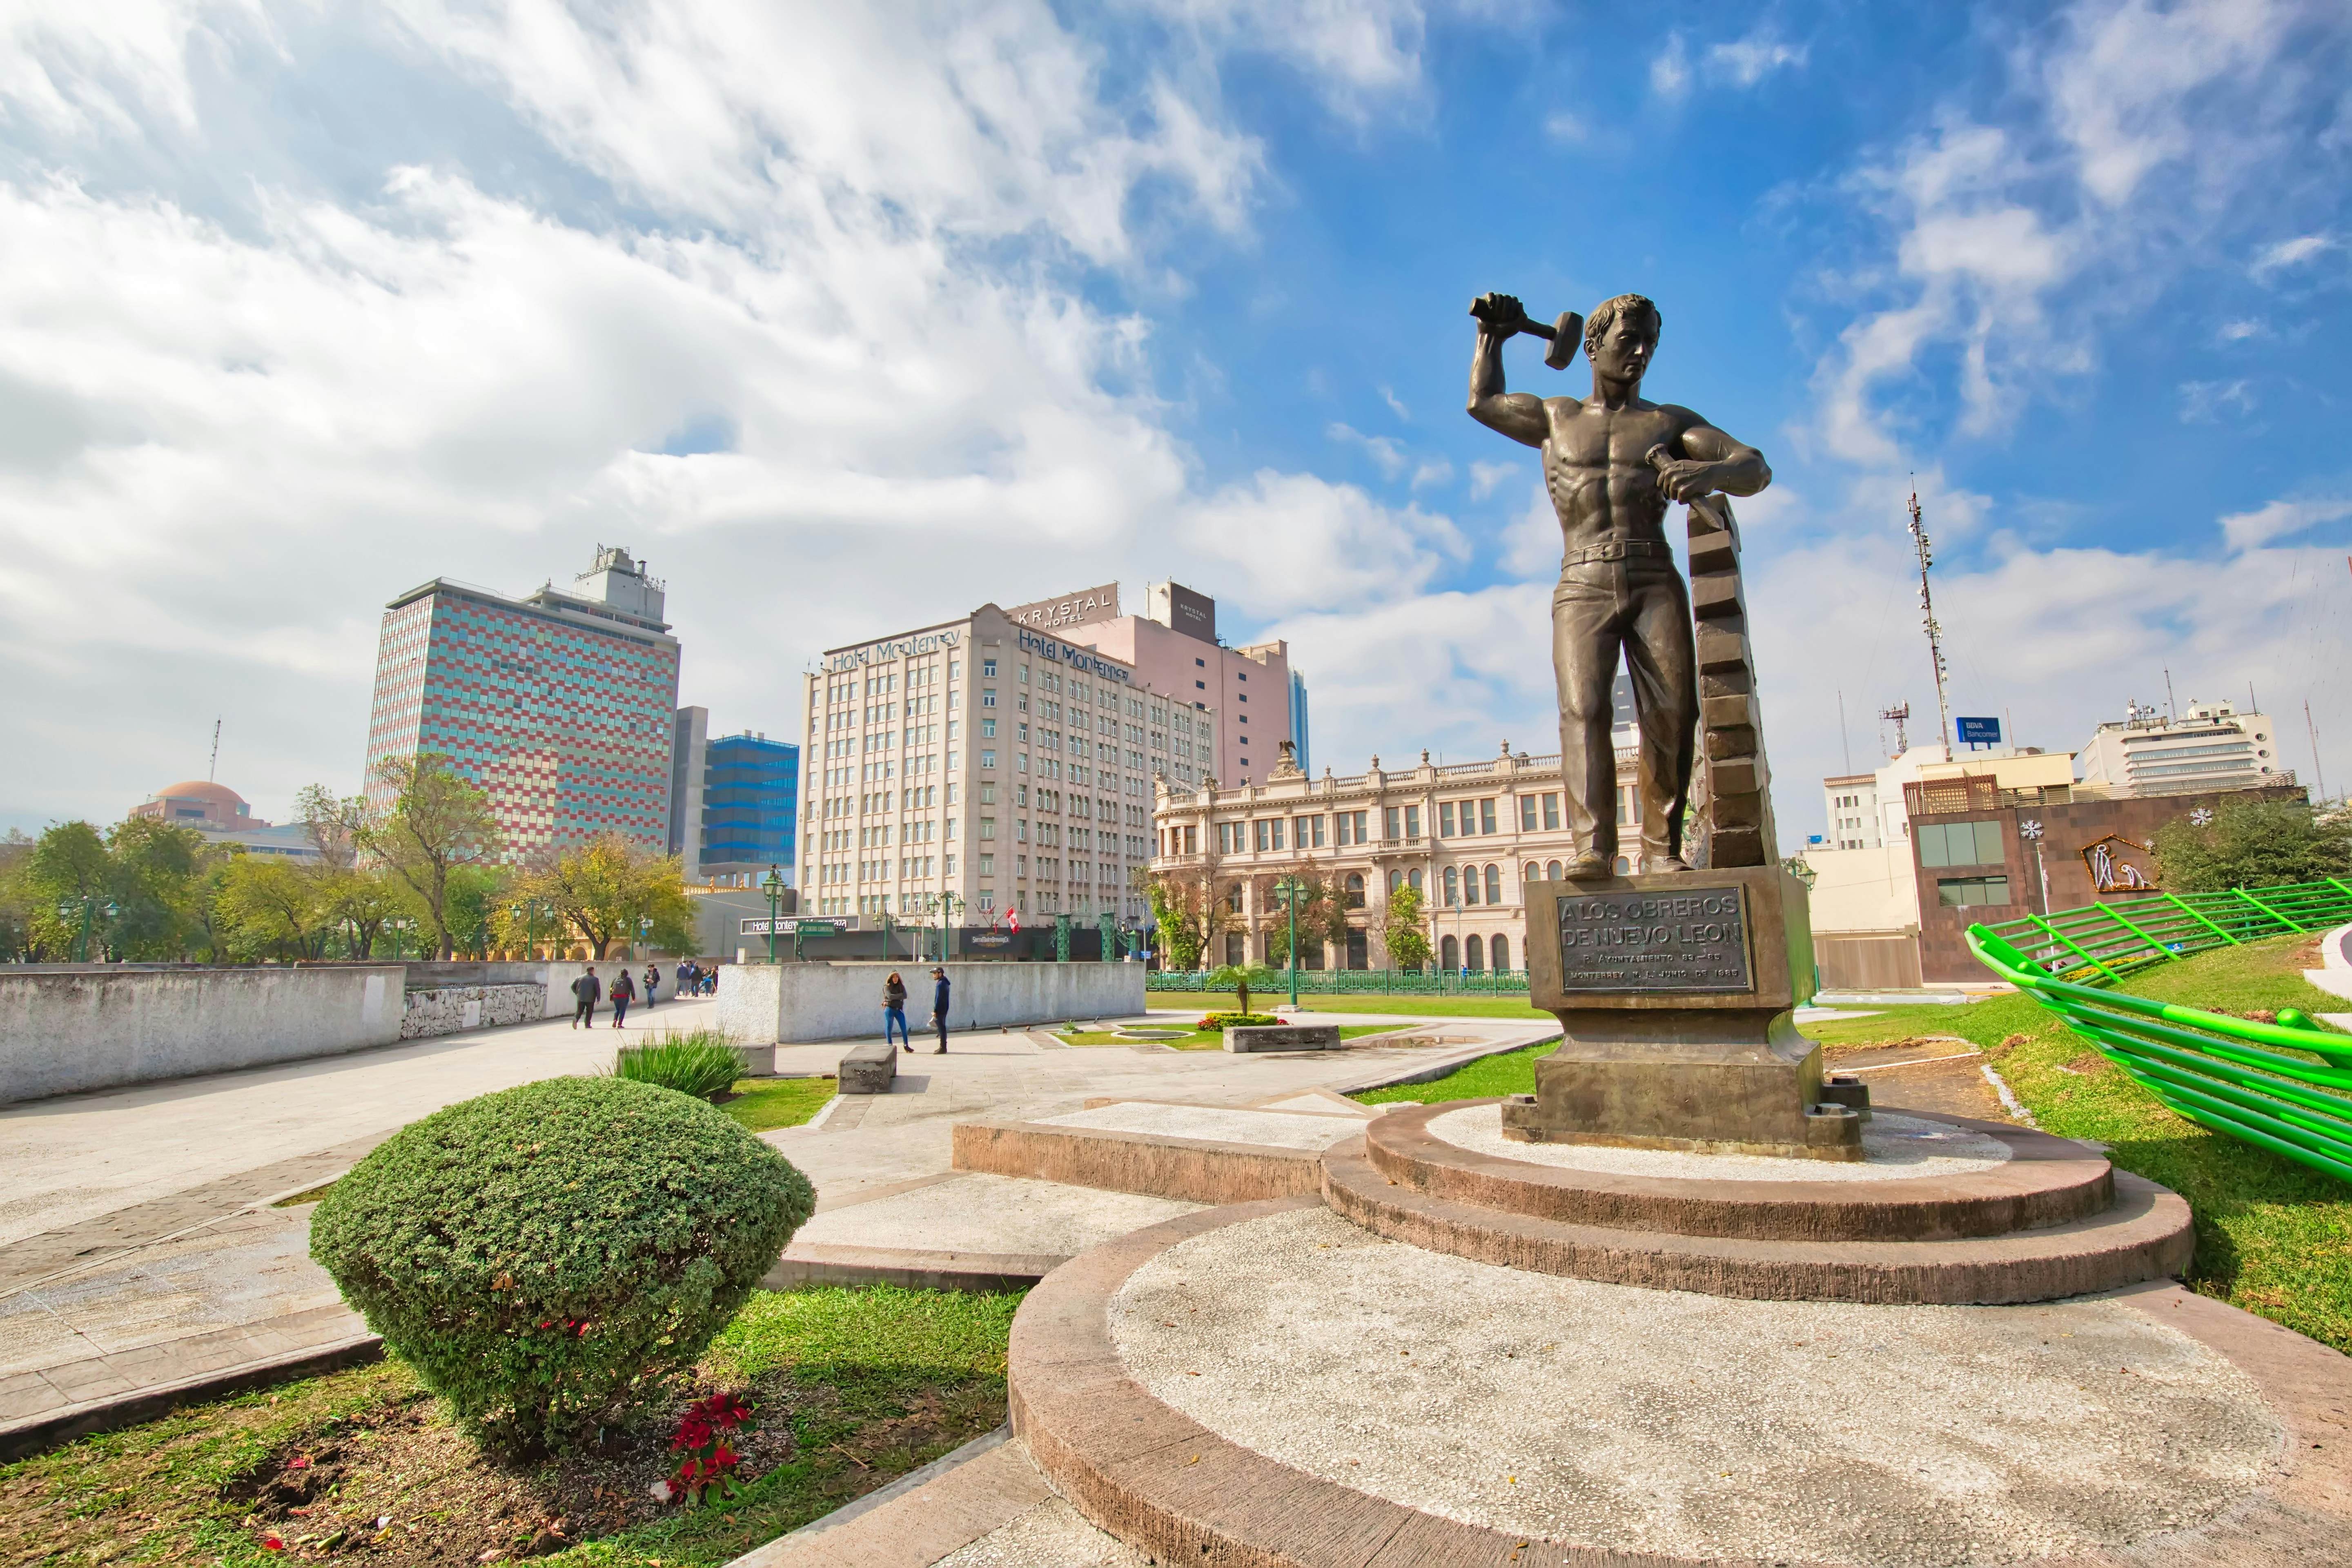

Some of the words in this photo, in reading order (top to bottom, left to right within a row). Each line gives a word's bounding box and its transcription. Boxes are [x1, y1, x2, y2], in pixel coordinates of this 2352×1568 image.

[1018, 594, 1111, 625] KRYSTAL
[1180, 603, 1207, 619] KRYSTAL
[1185, 612, 1201, 621] HOTEL
[1045, 613, 1085, 628] HOTEL
[1019, 629, 1056, 659] Hotel
[1561, 904, 1577, 922] A
[1578, 902, 1621, 921] LOS
[1626, 895, 1738, 919] OBREROS
[753, 921, 769, 931] Hotel
[1562, 928, 1591, 947] DE
[1594, 925, 1671, 946] NUEVO
[1676, 922, 1742, 944] LEON
[1598, 954, 1674, 964] AYUNTAMIENTO
[1659, 970, 1688, 979] JUNIO
[1715, 969, 1739, 977] 1985
